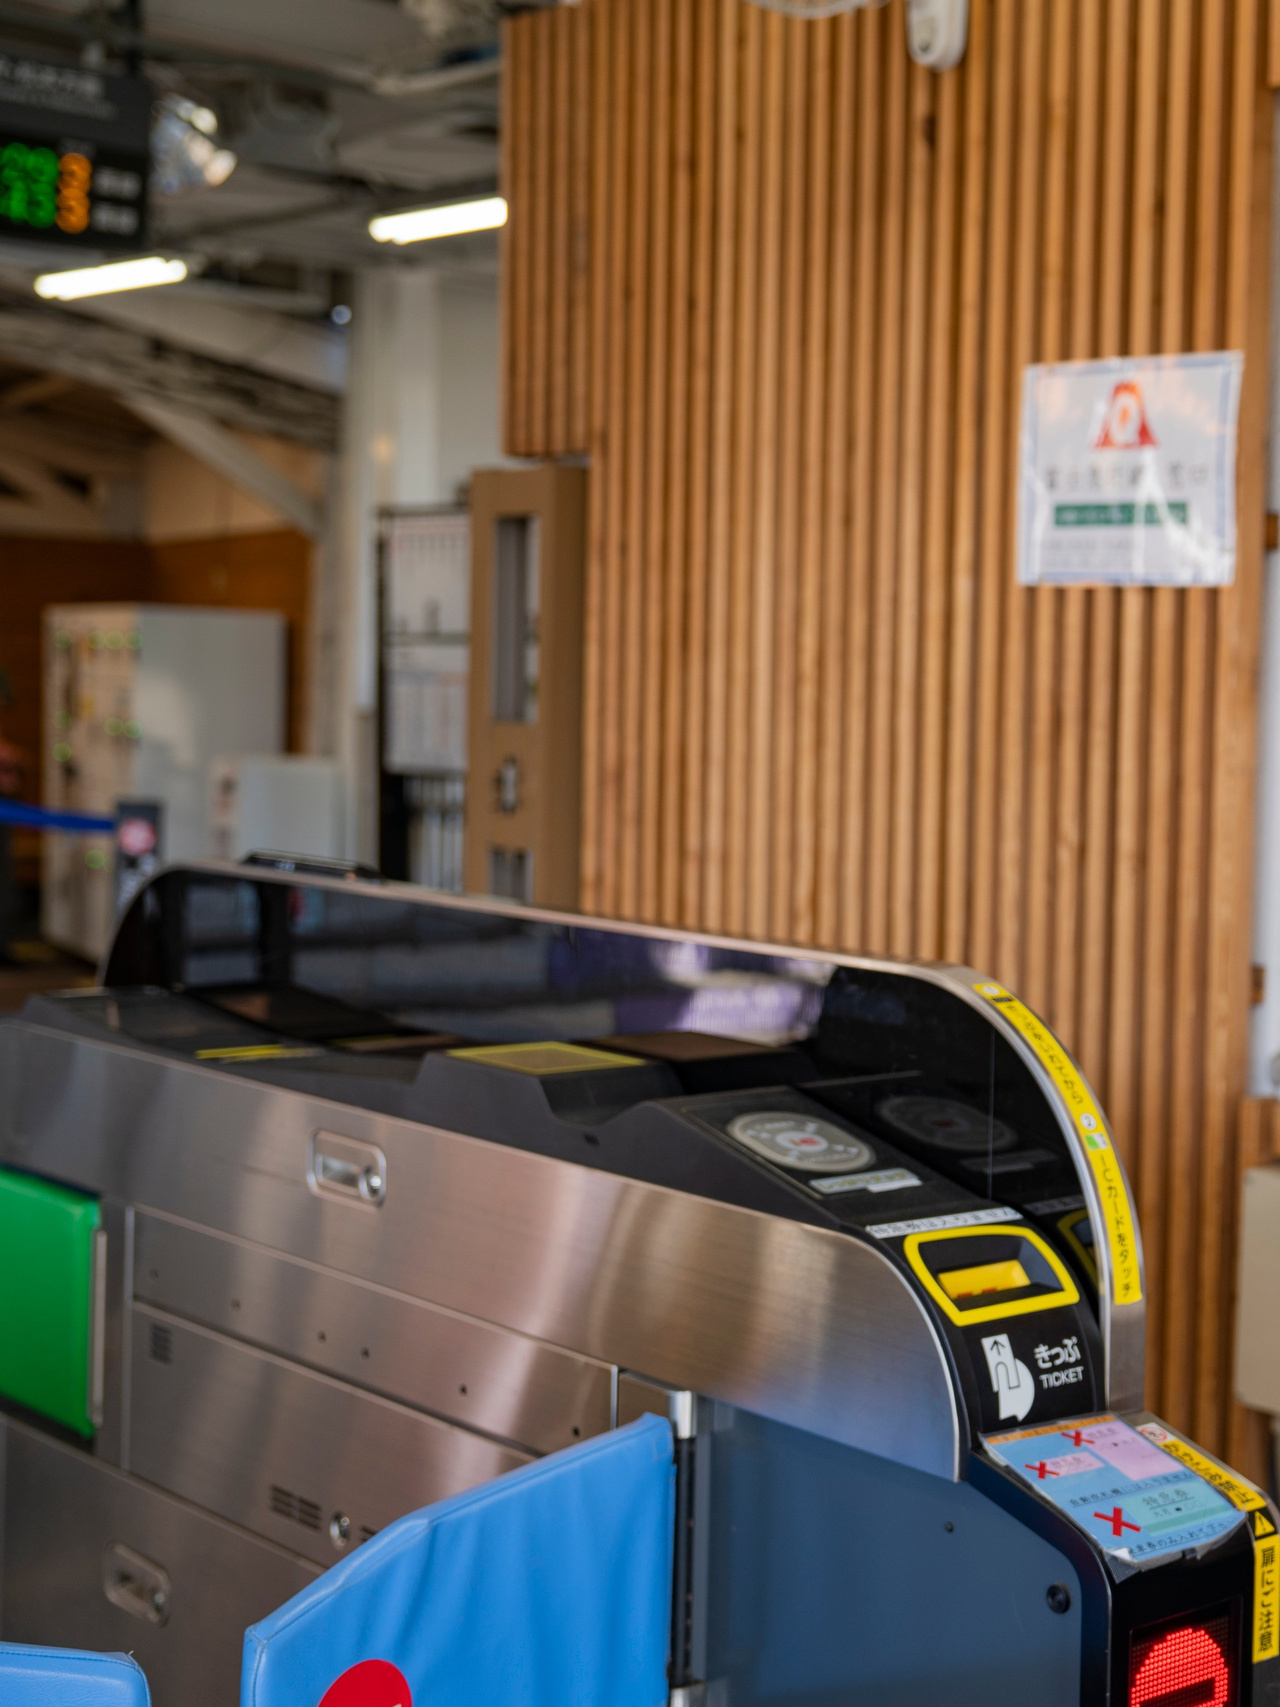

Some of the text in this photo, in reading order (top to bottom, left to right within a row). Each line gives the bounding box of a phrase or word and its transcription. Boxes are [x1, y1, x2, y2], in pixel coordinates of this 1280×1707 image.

[1100, 1153, 1132, 1297] ICカードをタッチ
[1033, 1335, 1082, 1369] きっぷ
[1039, 1366, 1084, 1390] TICKET
[1258, 1545, 1276, 1652] 扉にご注意
